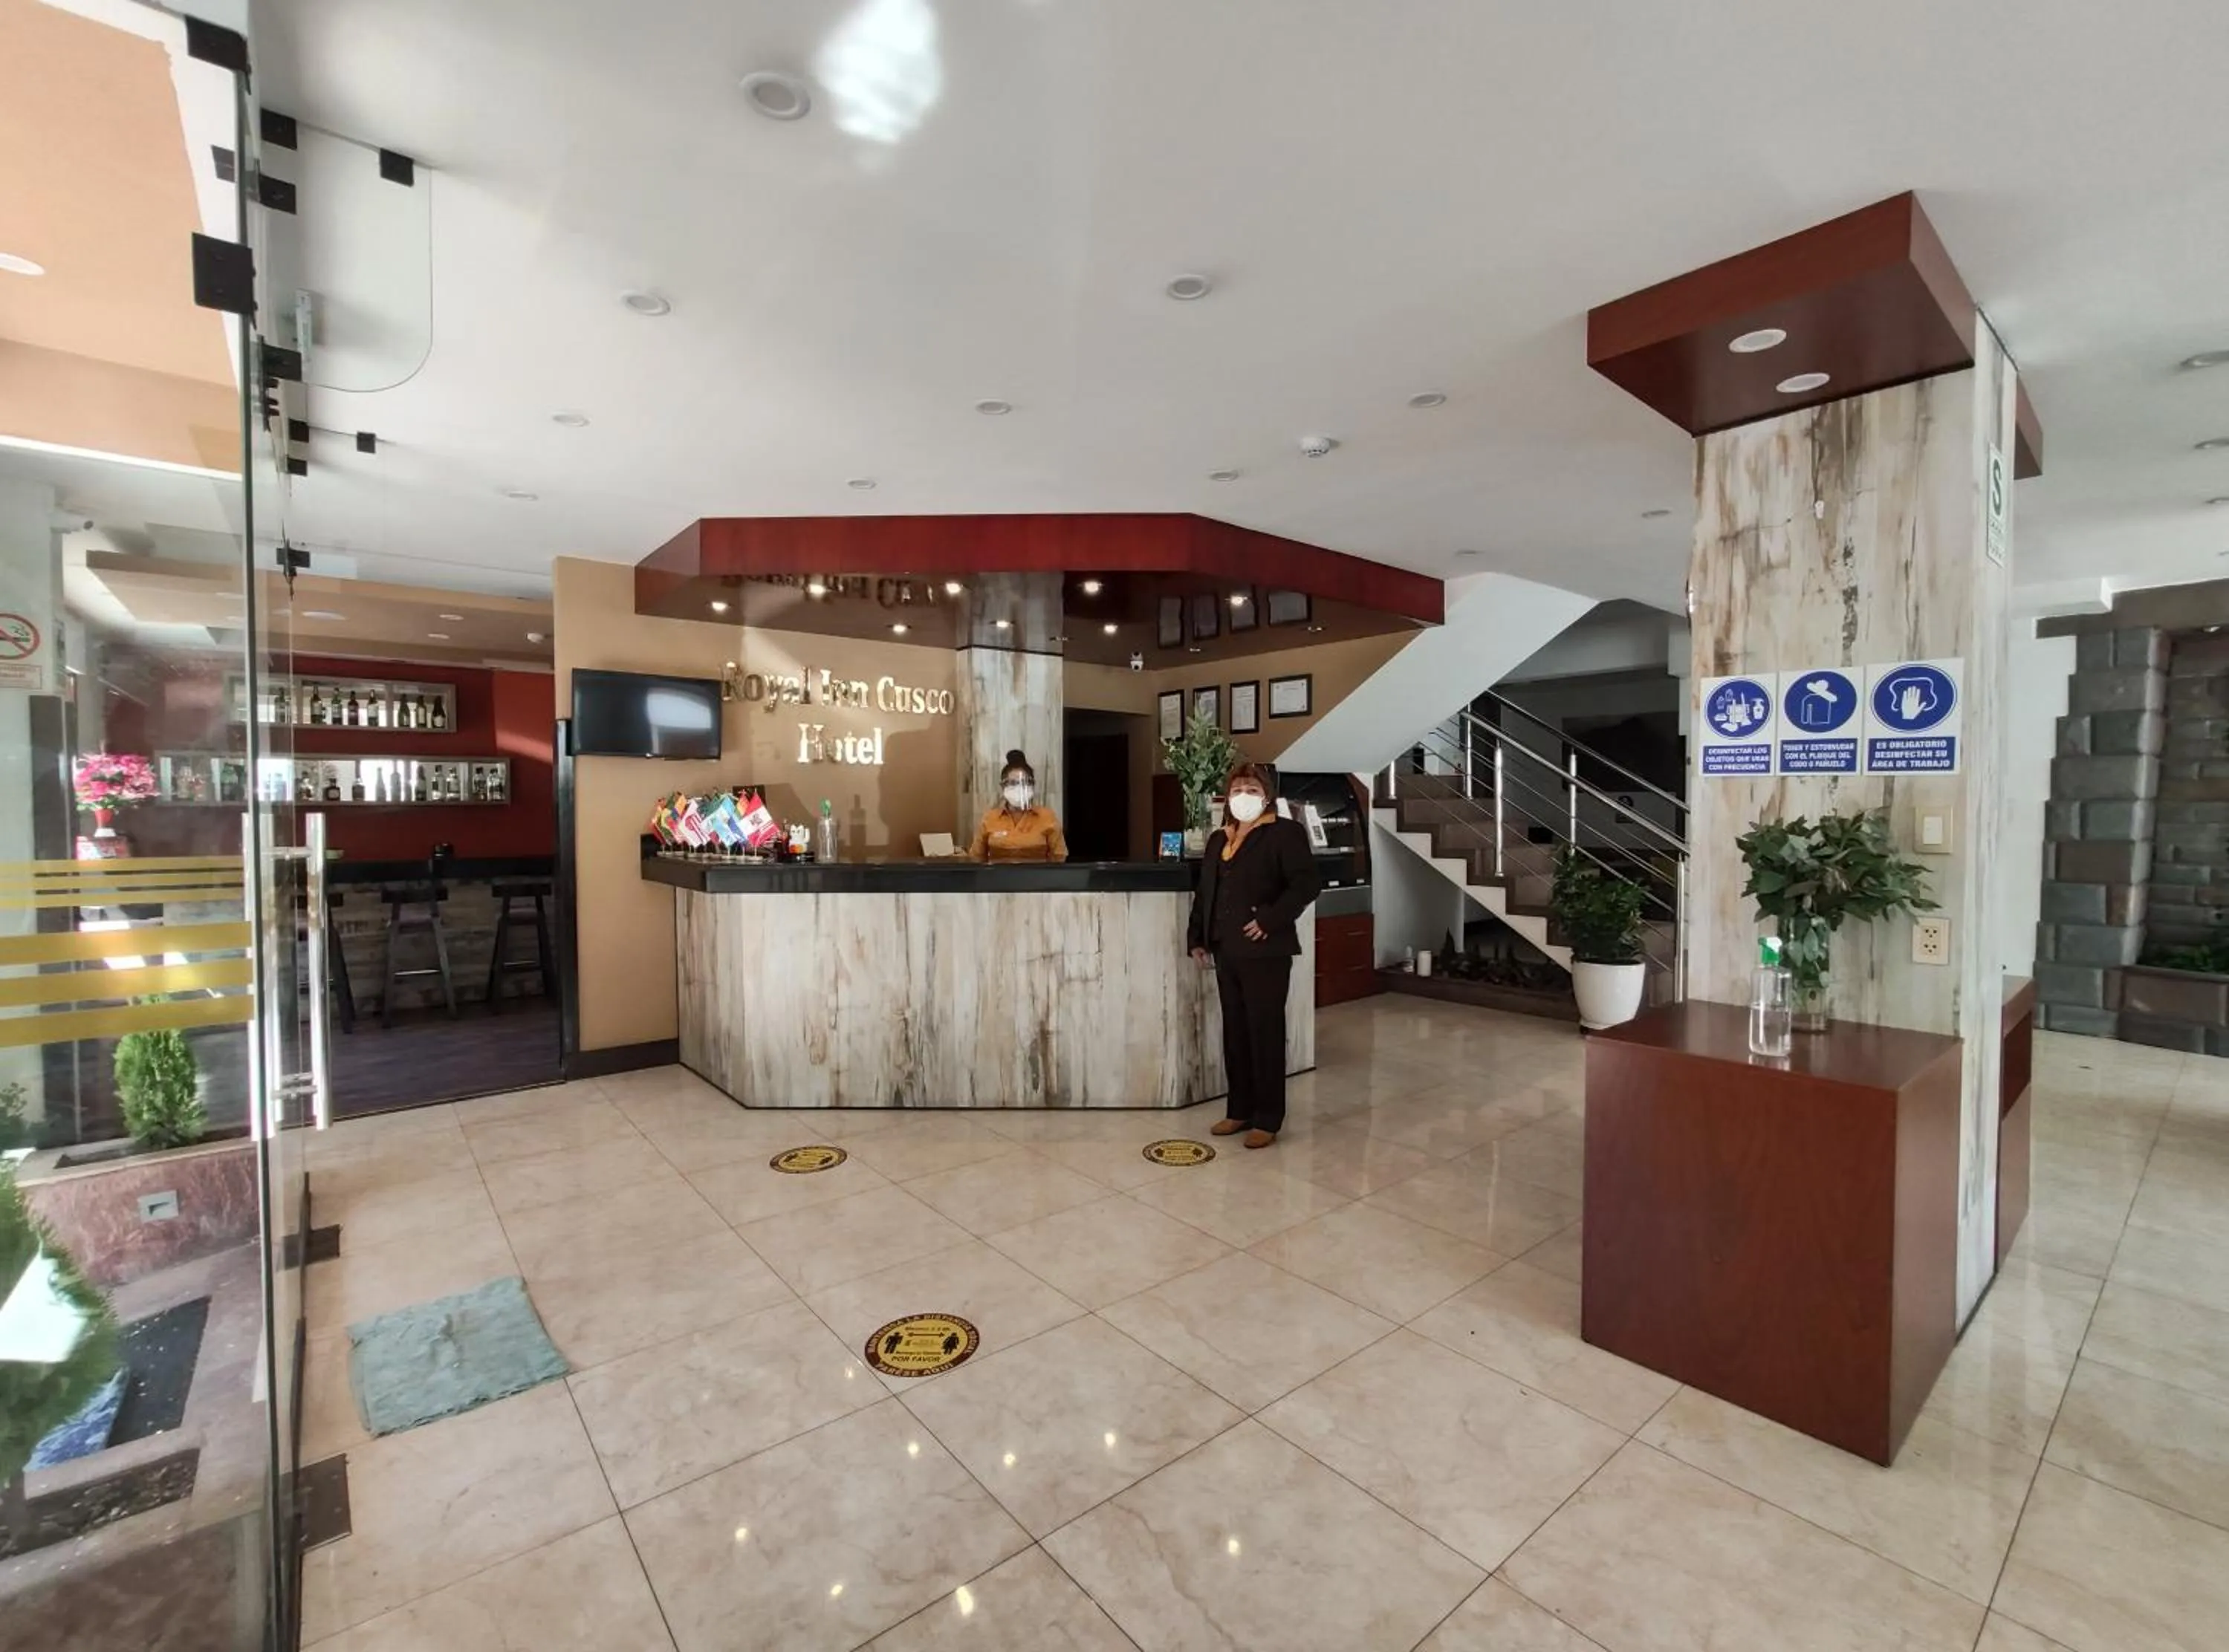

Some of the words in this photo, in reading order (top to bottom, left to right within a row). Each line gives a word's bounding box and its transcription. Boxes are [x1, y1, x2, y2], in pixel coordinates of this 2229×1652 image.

[721, 663, 812, 713] Royal
[820, 669, 869, 709] Inn
[877, 676, 955, 715] Cusco
[797, 723, 884, 765] Hotel
[1876, 741, 1886, 749] ES
[1889, 739, 1947, 749] OBLIGATORIO
[1875, 750, 1933, 758] DESINFECTAR
[1935, 749, 1948, 758] SU
[1724, 762, 1766, 770] FRECUENCIA
[1895, 759, 1908, 767] DE
[1909, 758, 1950, 767] TRABAJO
